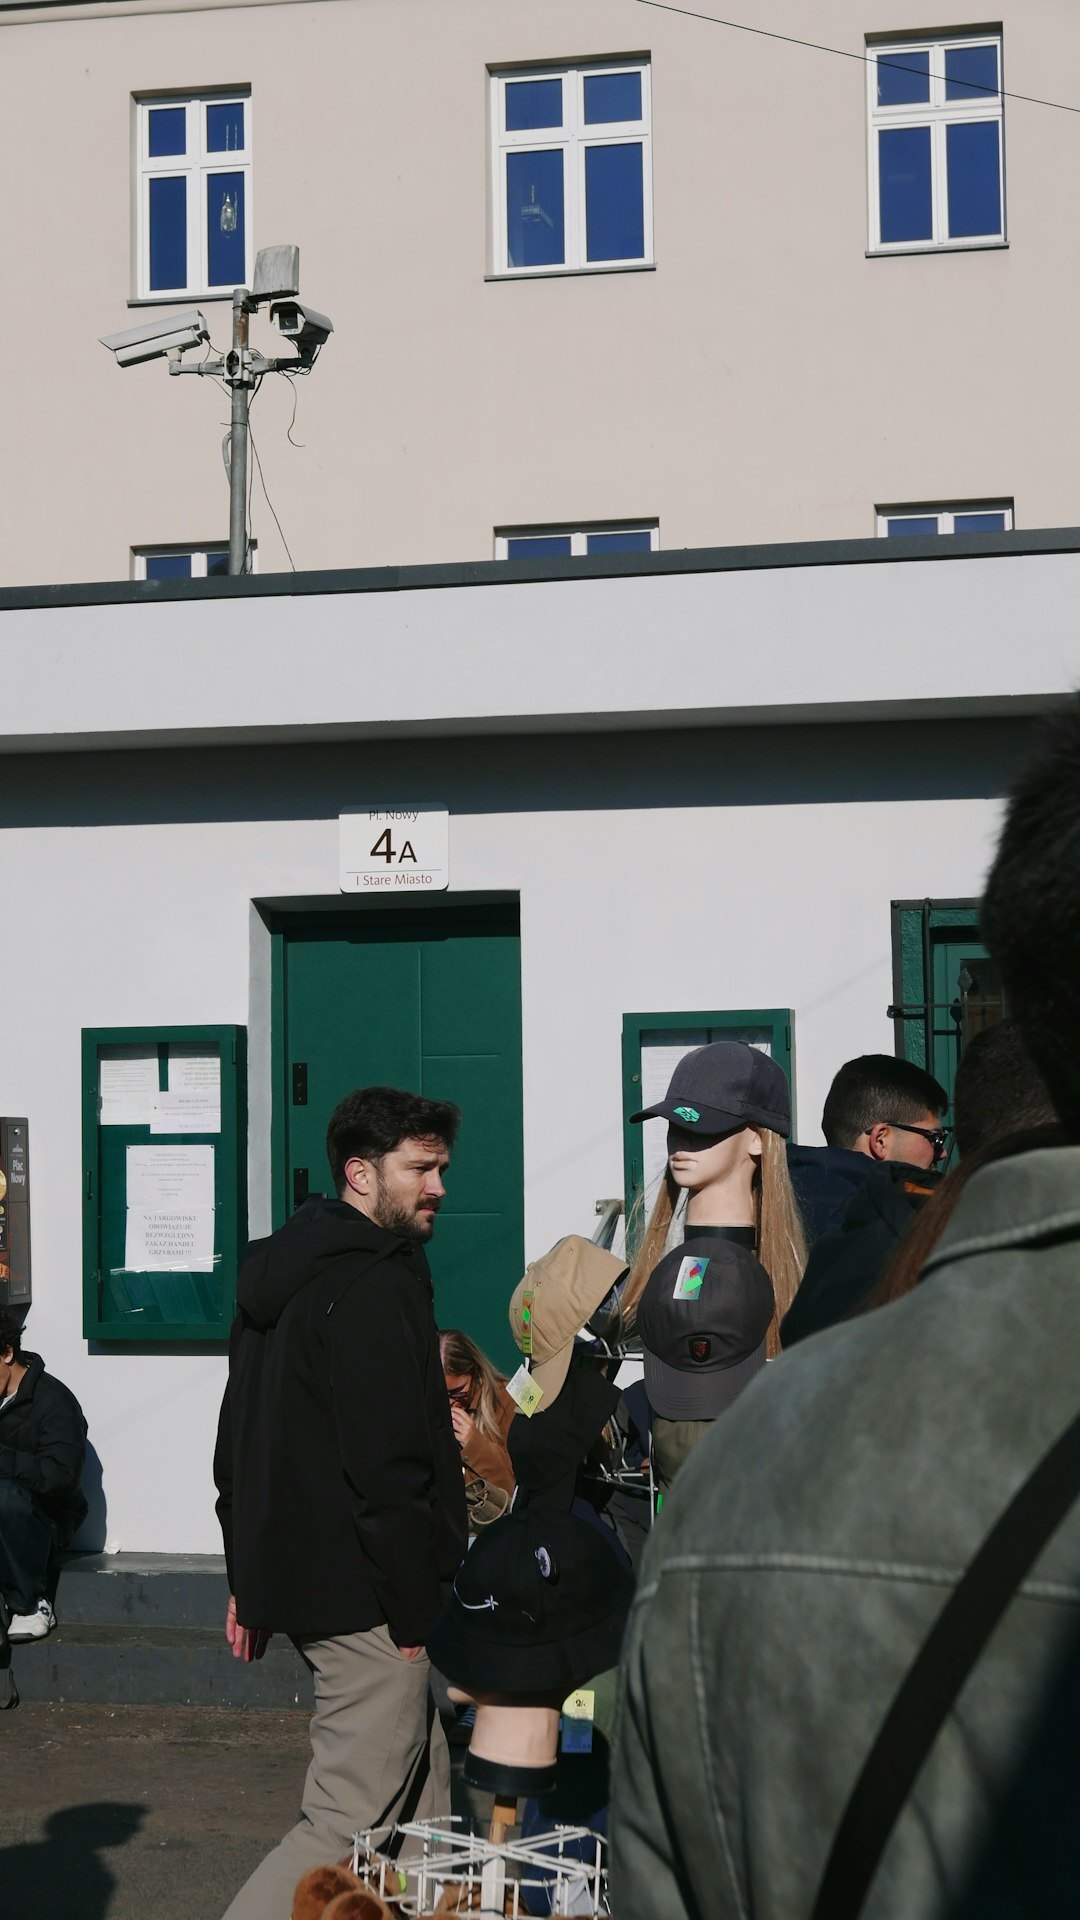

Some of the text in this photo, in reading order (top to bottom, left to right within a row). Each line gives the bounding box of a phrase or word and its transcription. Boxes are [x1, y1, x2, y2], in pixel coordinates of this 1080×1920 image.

[369, 809, 419, 823] Pl. Nowy
[370, 828, 418, 864] 4A
[356, 873, 433, 886] I Stare Miasto
[12, 1159, 24, 1171] Plac
[10, 1172, 26, 1186] Nowy
